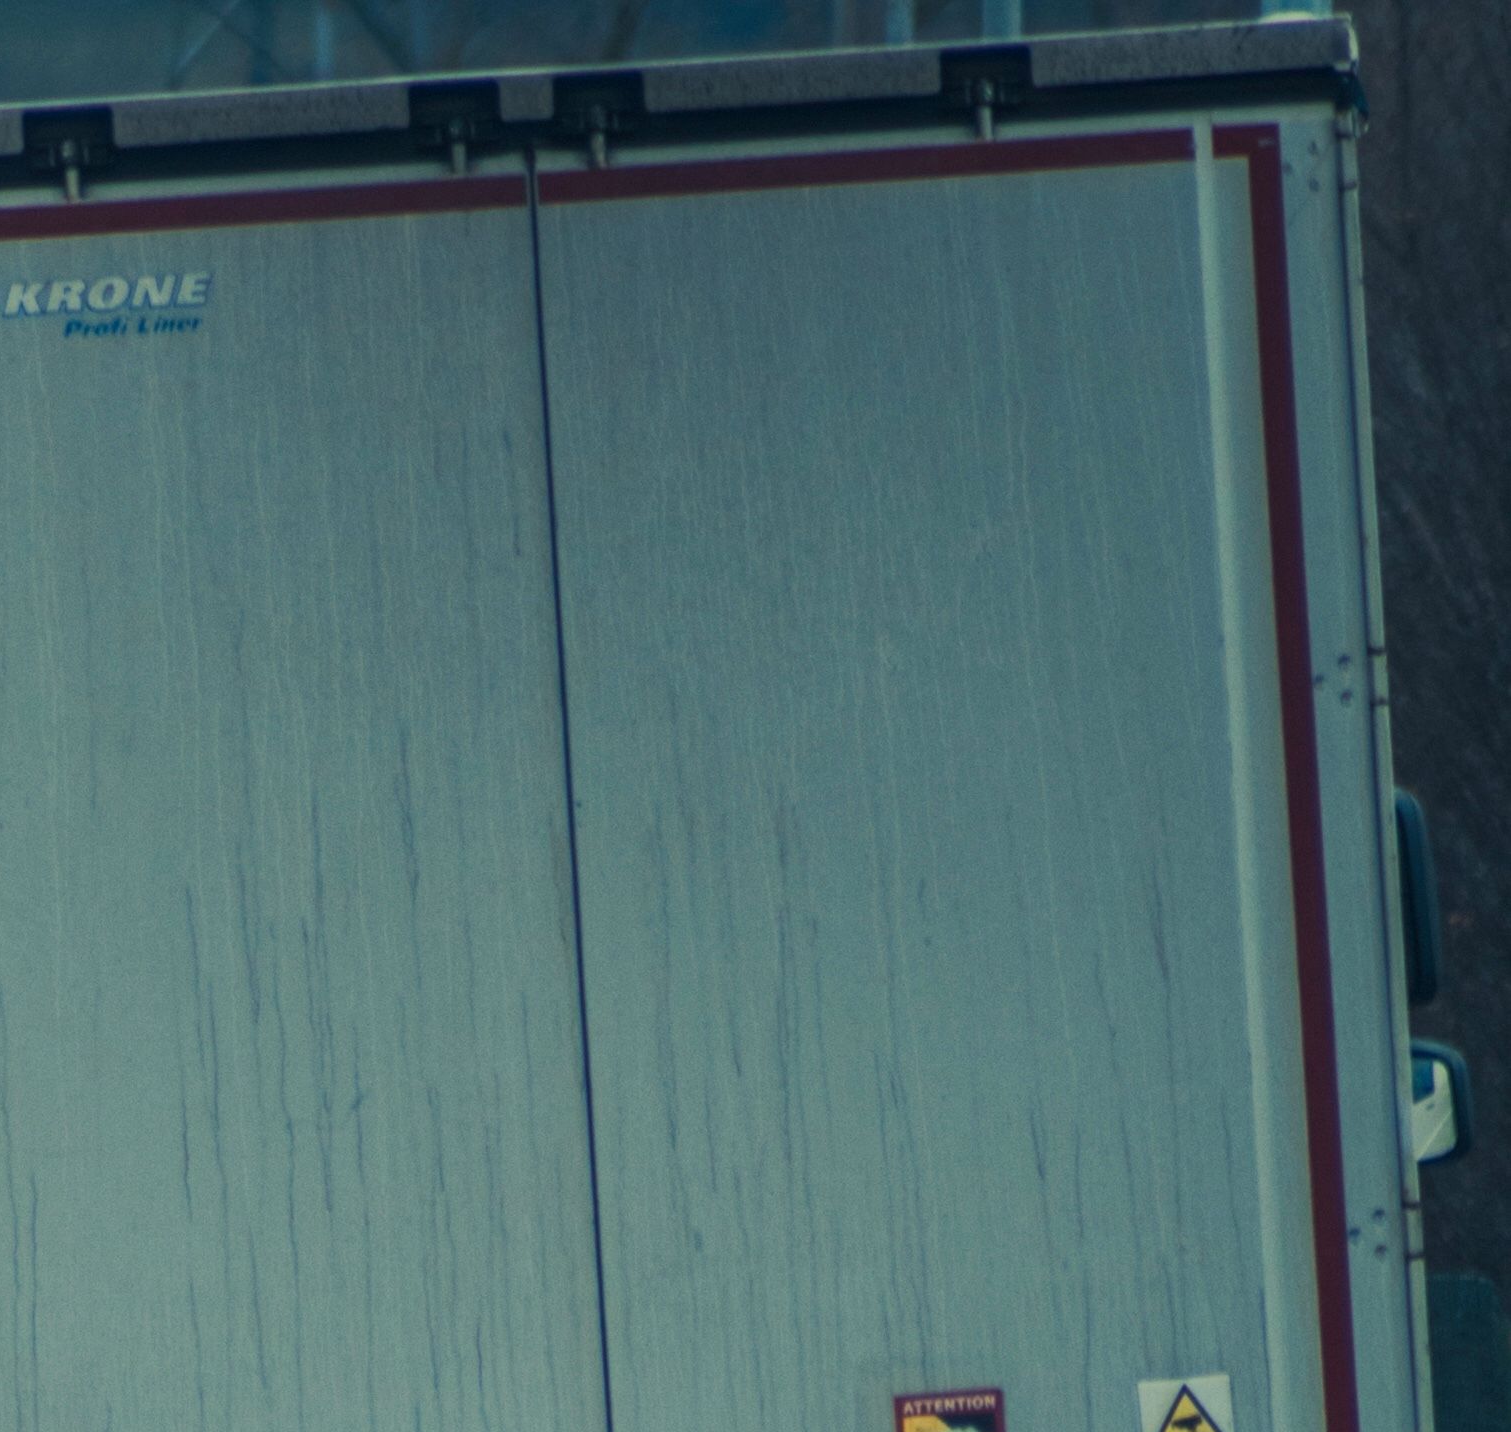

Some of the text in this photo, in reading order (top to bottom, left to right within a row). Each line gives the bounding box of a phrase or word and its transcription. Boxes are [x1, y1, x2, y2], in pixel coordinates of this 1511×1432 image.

[3, 271, 211, 318] KRONE
[63, 317, 202, 338] Profi Liner
[903, 1395, 996, 1415] ATTENTION
